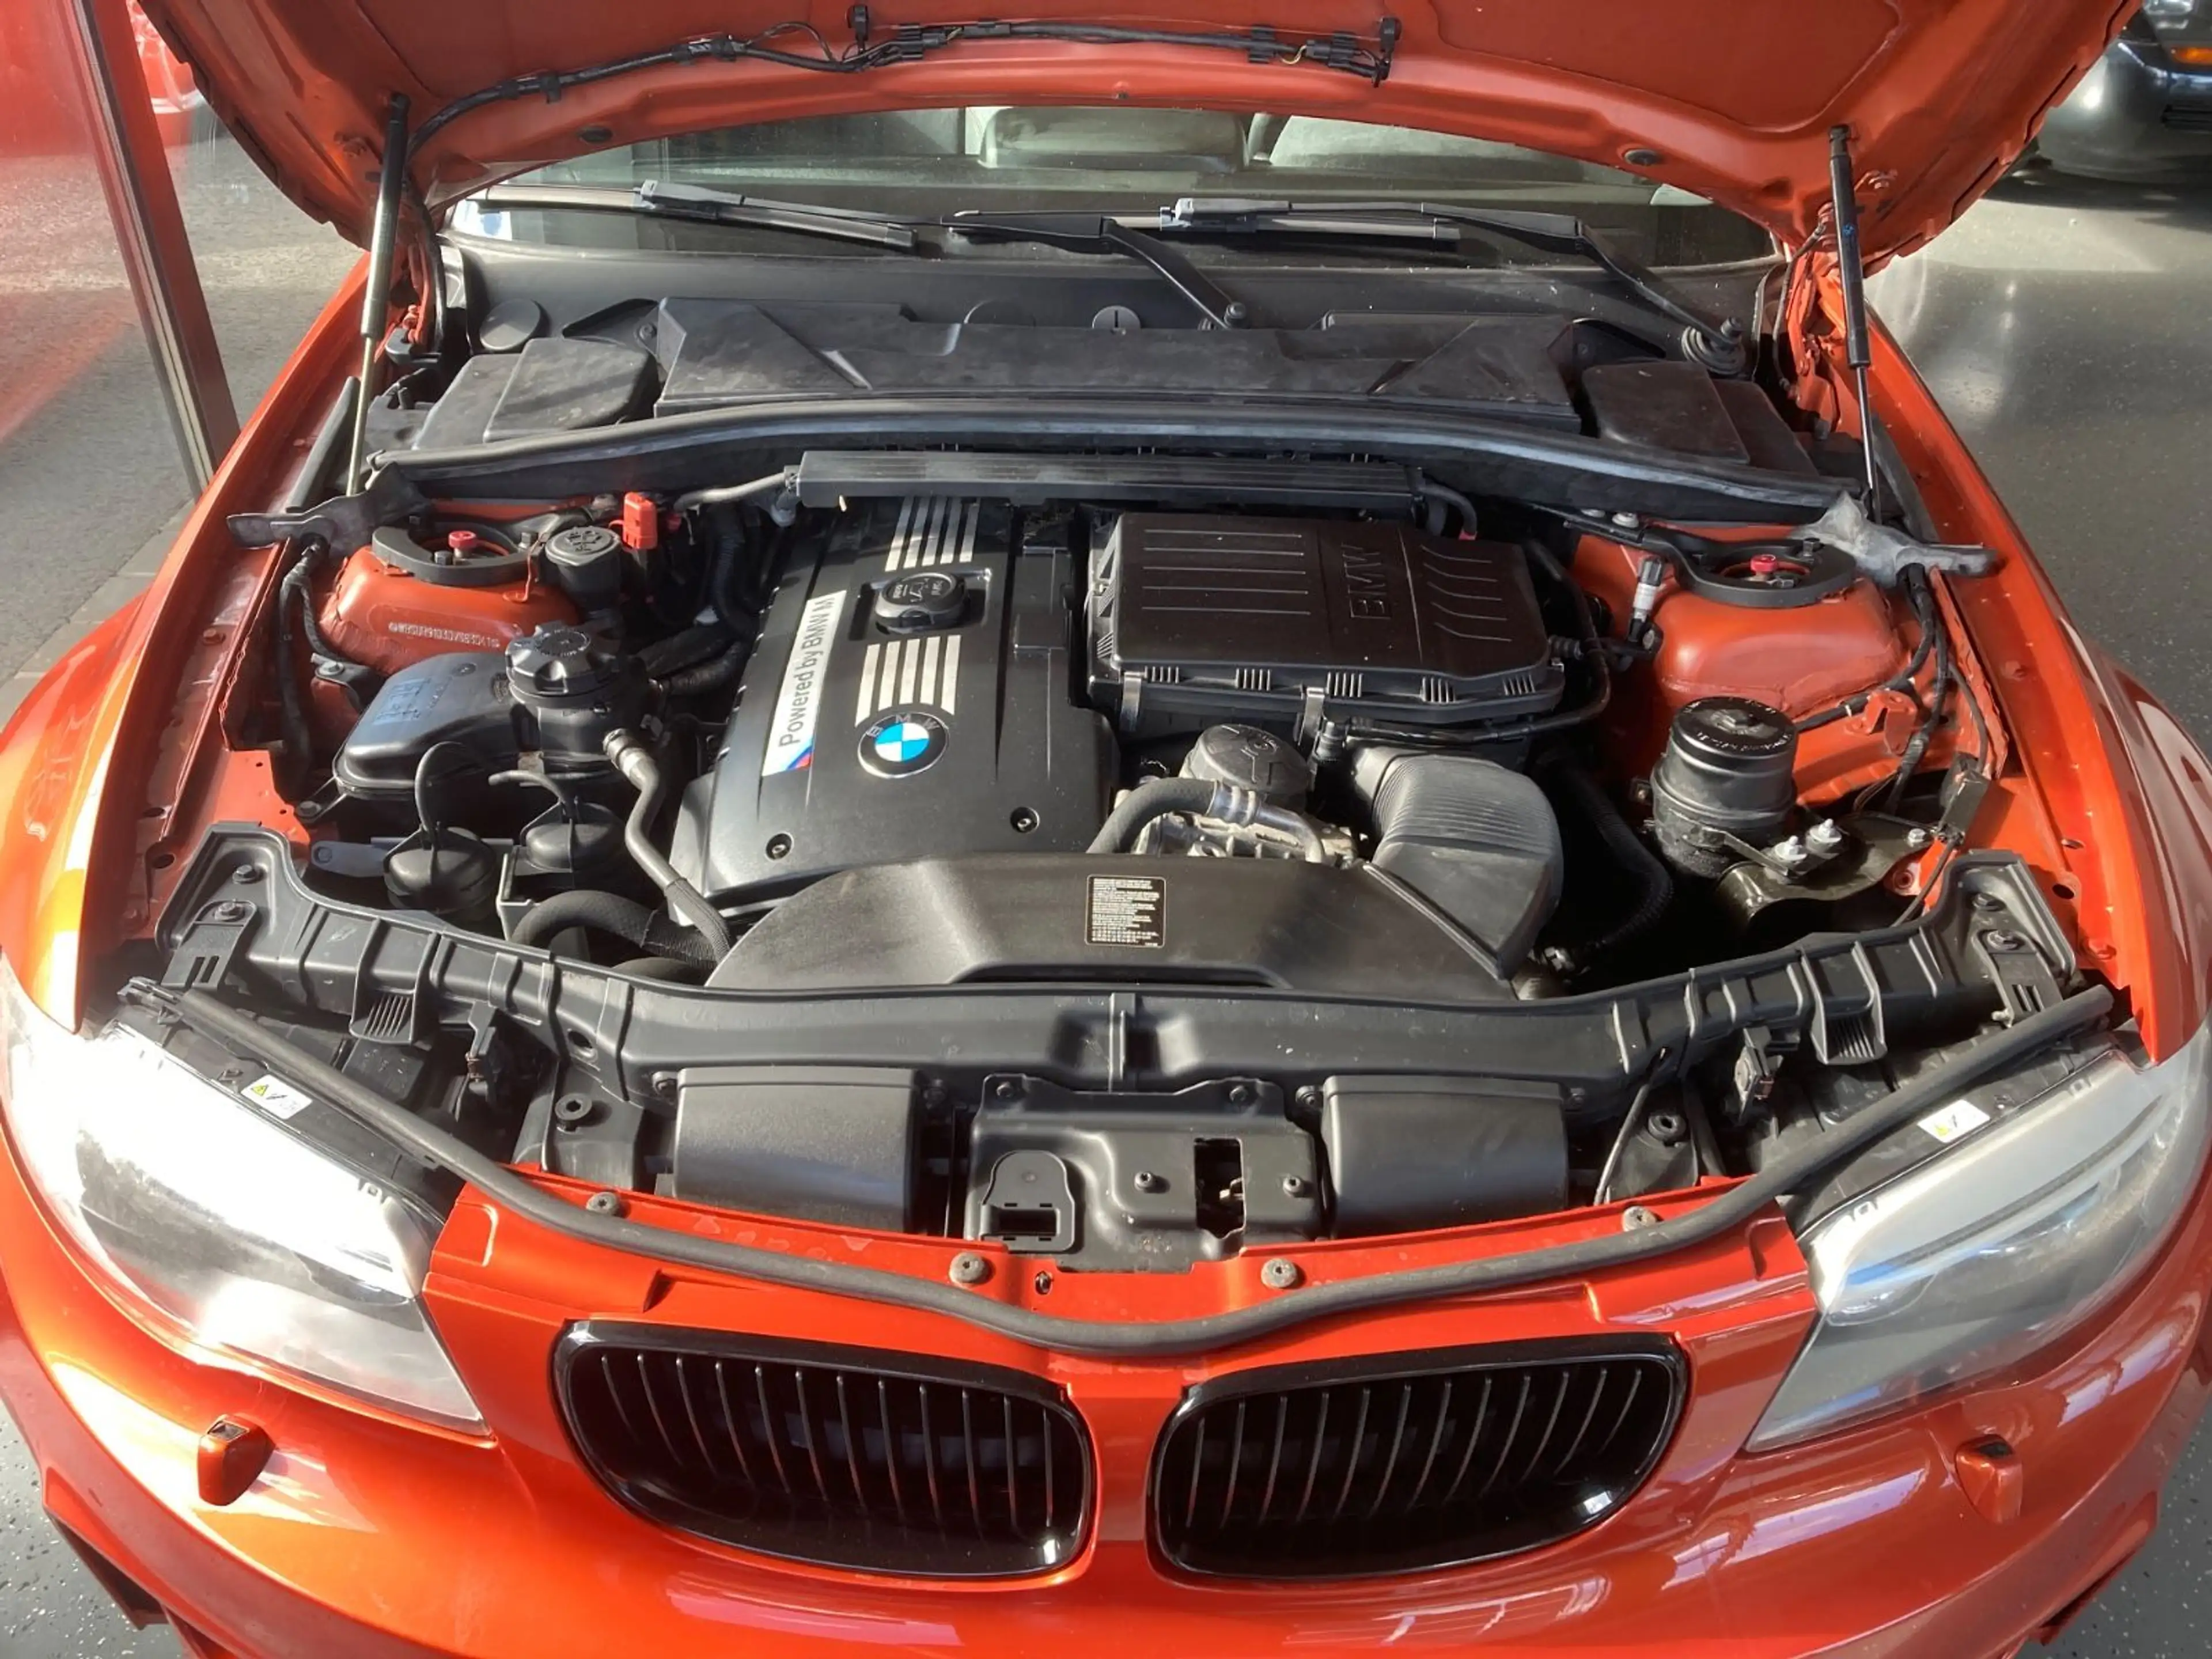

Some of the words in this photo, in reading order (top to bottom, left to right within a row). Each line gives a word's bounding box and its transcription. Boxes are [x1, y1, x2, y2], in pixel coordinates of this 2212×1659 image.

[1341, 541, 1392, 619] BMW
[812, 597, 836, 612] M
[801, 613, 830, 650] BMW
[794, 651, 824, 670] by
[778, 670, 815, 747] Powered
[866, 714, 940, 738] BMW
